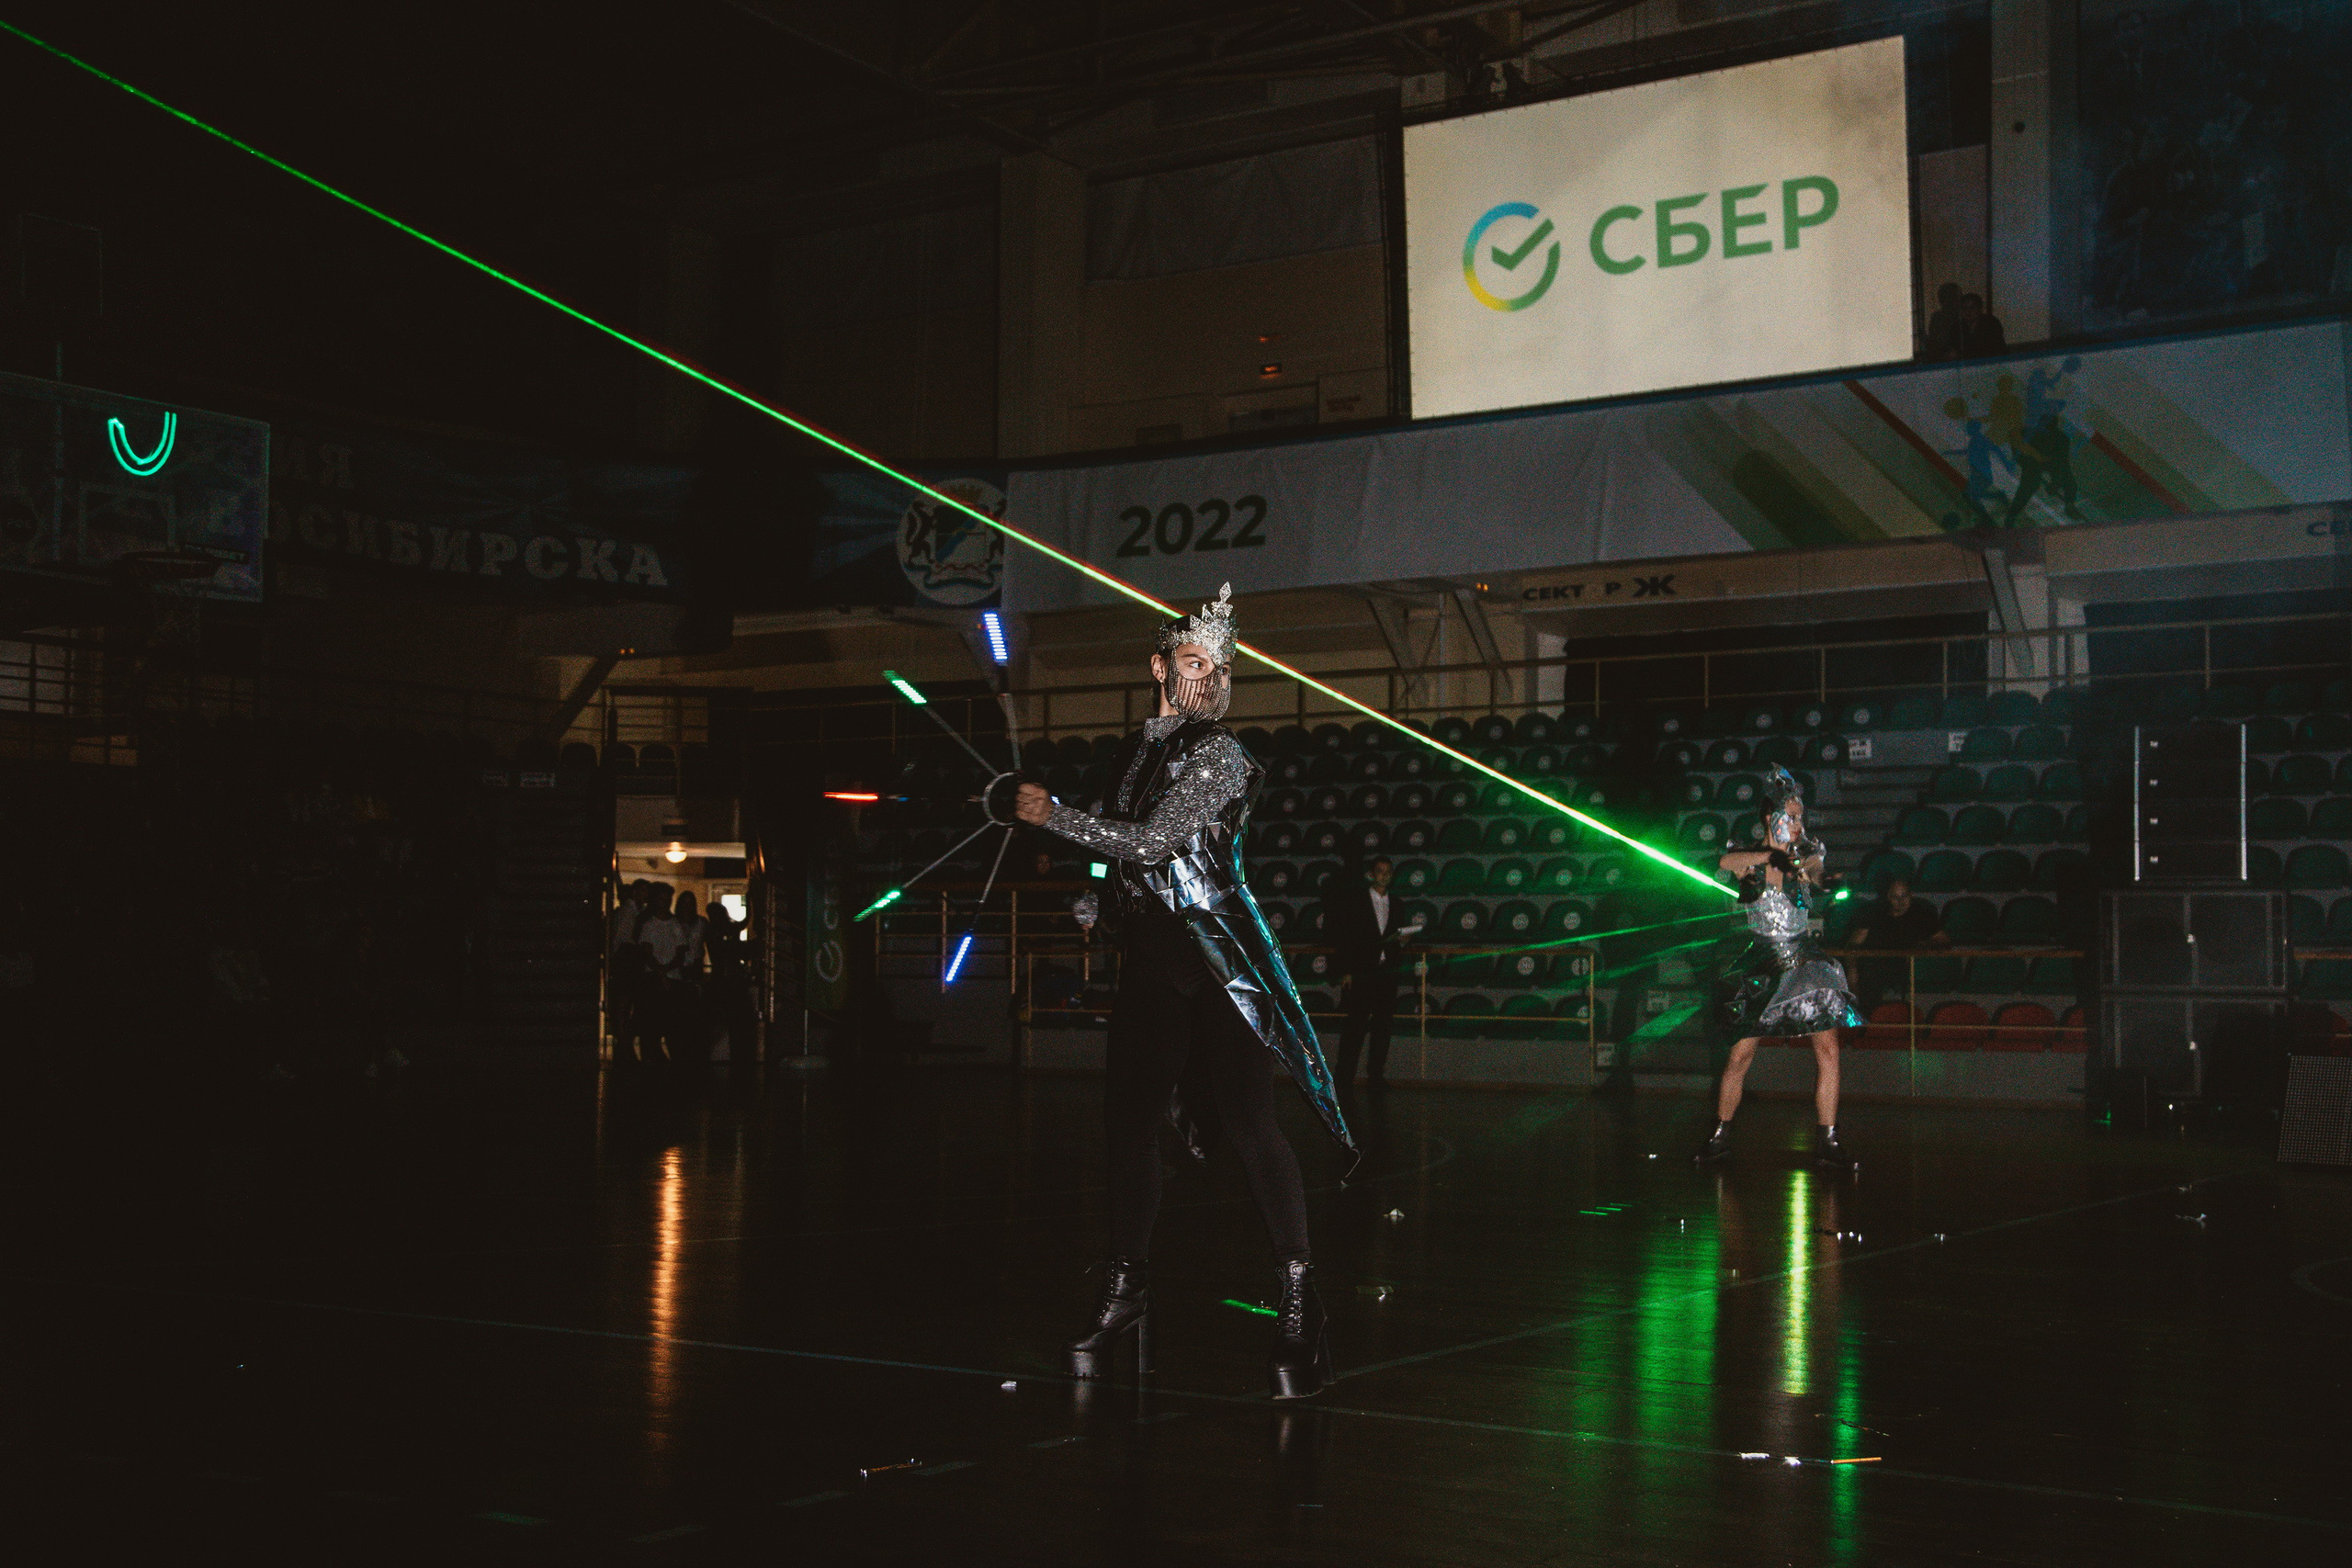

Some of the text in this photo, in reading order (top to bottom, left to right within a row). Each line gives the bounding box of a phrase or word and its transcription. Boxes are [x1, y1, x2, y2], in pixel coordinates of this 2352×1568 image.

[1589, 175, 1839, 276] СБЕР
[1117, 494, 1268, 558] 2022
[1633, 574, 1677, 597] Ж
